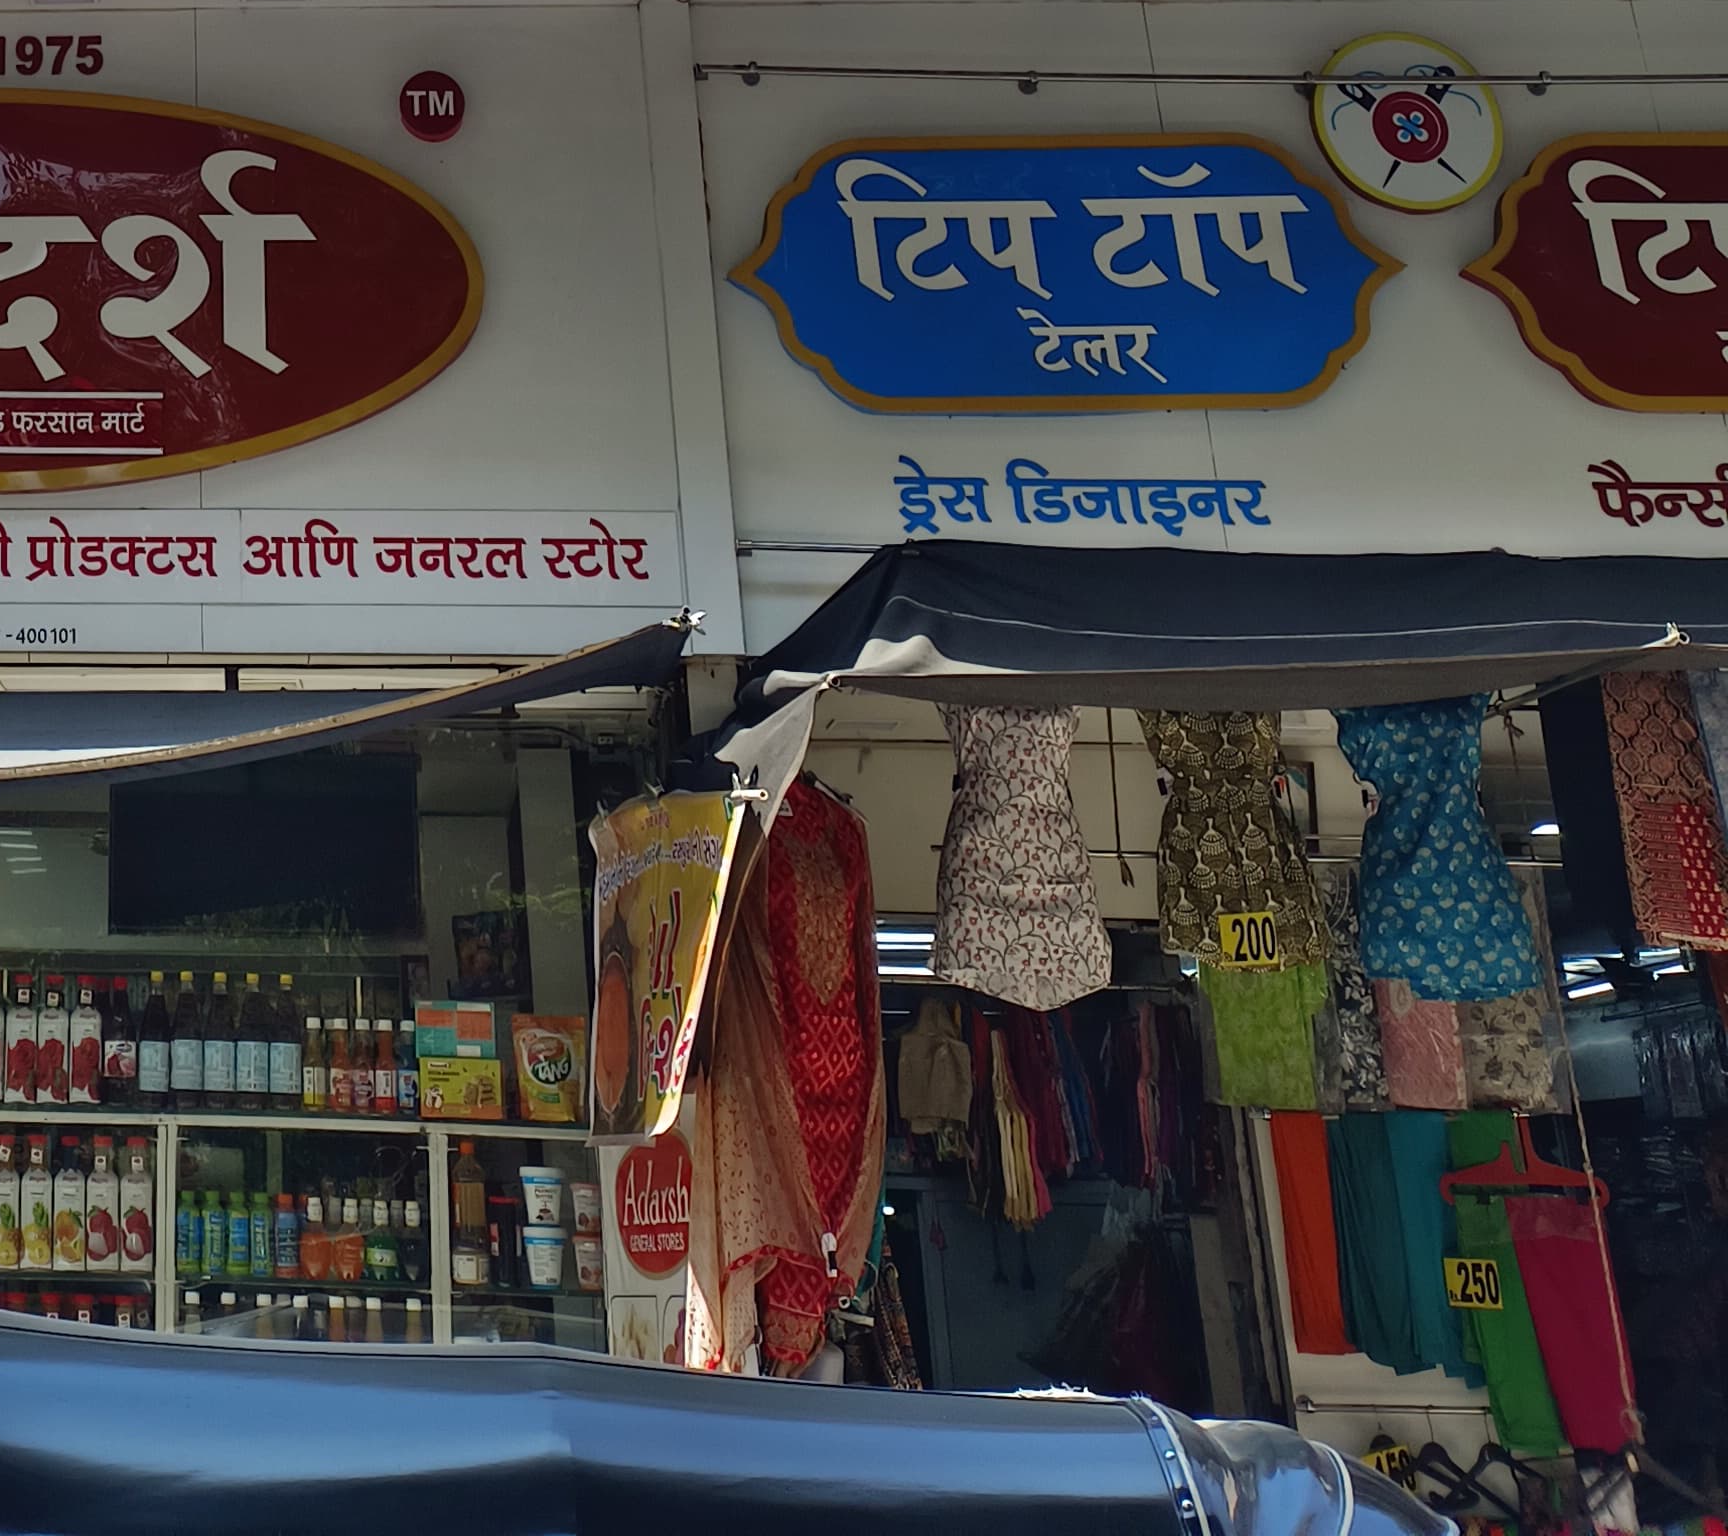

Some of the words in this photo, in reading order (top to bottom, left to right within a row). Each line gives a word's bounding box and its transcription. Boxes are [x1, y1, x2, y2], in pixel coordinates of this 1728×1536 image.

[406, 90, 456, 118] TM
[834, 158, 1058, 302] टिप
[1081, 161, 1311, 297] टॉप
[1567, 159, 1728, 306] टि
[1016, 306, 1168, 384] टेलर
[11, 409, 95, 435] फरसान
[101, 402, 145, 434] मार्ट
[894, 455, 992, 534] ड्रेस
[1006, 458, 1272, 537] डिजाइनर
[242, 518, 358, 580] आणि
[374, 537, 527, 582] जनरल
[540, 518, 650, 583] स्टोर
[1231, 916, 1276, 962] 200
[534, 1059, 570, 1083] TANG
[623, 1155, 691, 1226] Adarsh
[1456, 1262, 1500, 1305] 250
